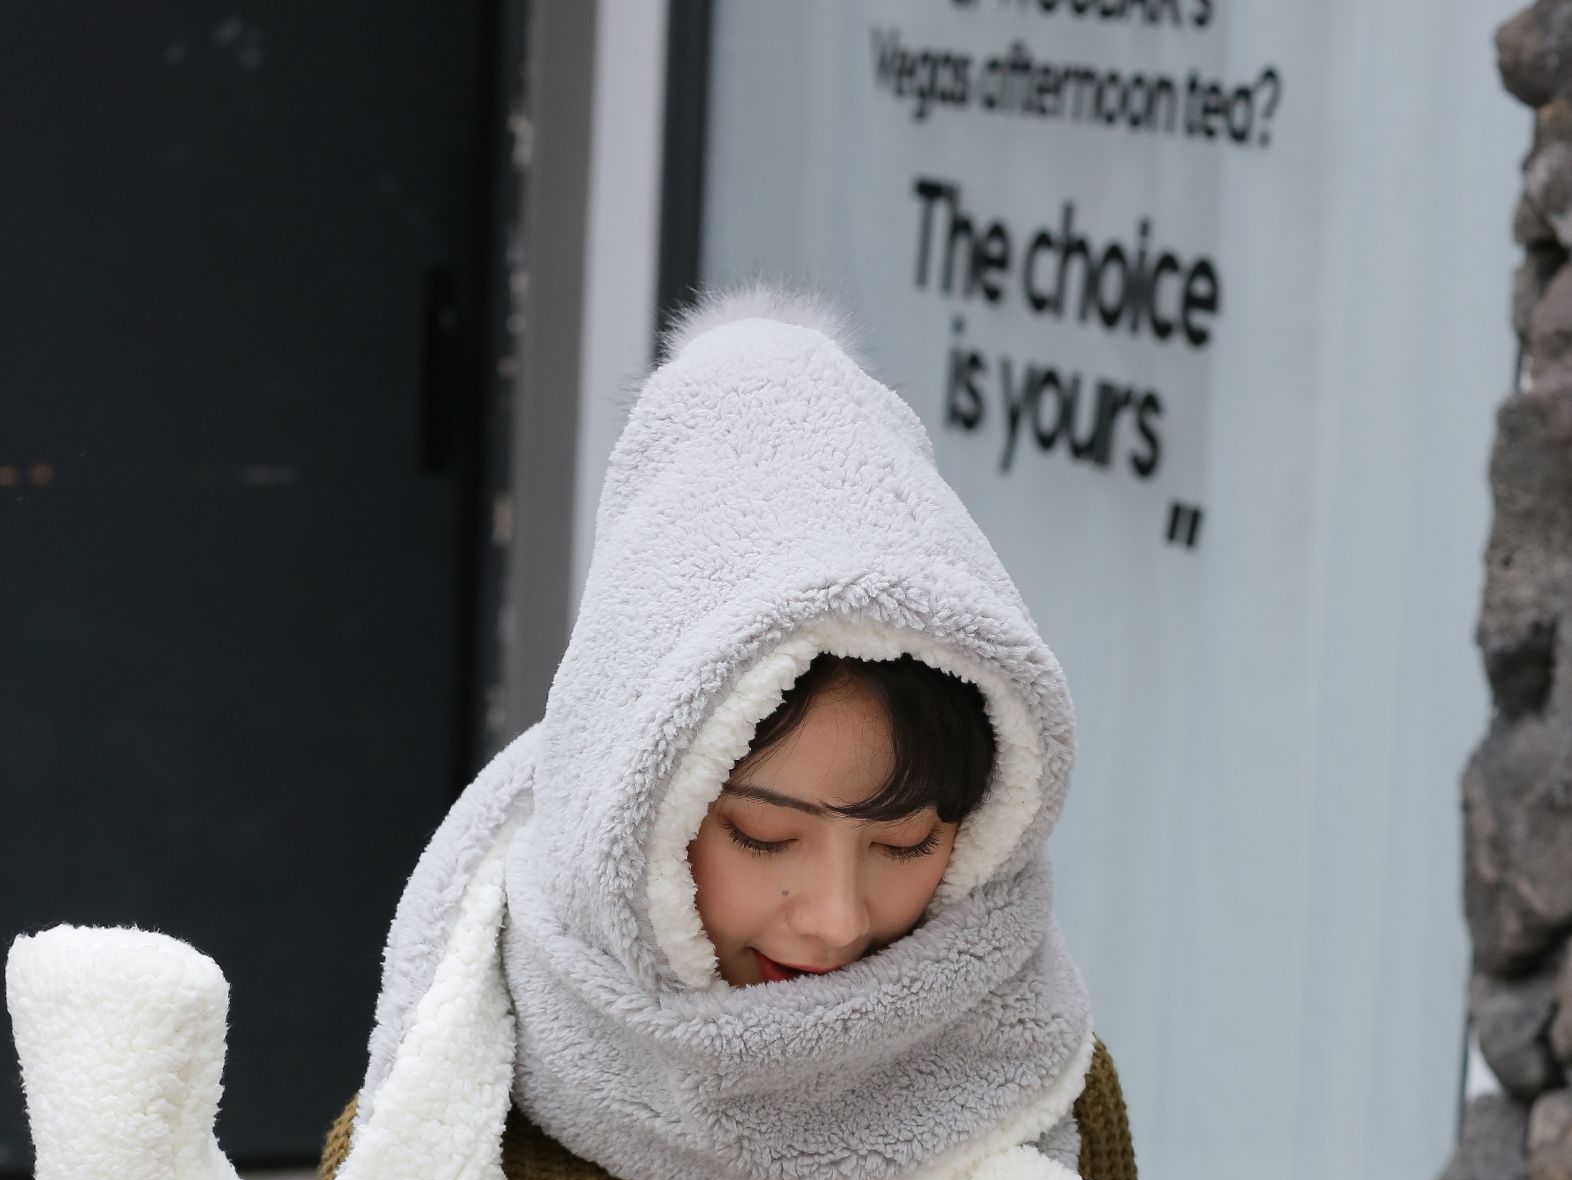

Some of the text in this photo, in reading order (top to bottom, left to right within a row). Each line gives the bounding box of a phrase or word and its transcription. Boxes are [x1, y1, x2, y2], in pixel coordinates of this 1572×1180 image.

[981, 40, 1178, 134] afternoon
[1184, 66, 1282, 146] tea?
[912, 174, 1220, 347] The choice
[946, 312, 1163, 477] is yours
